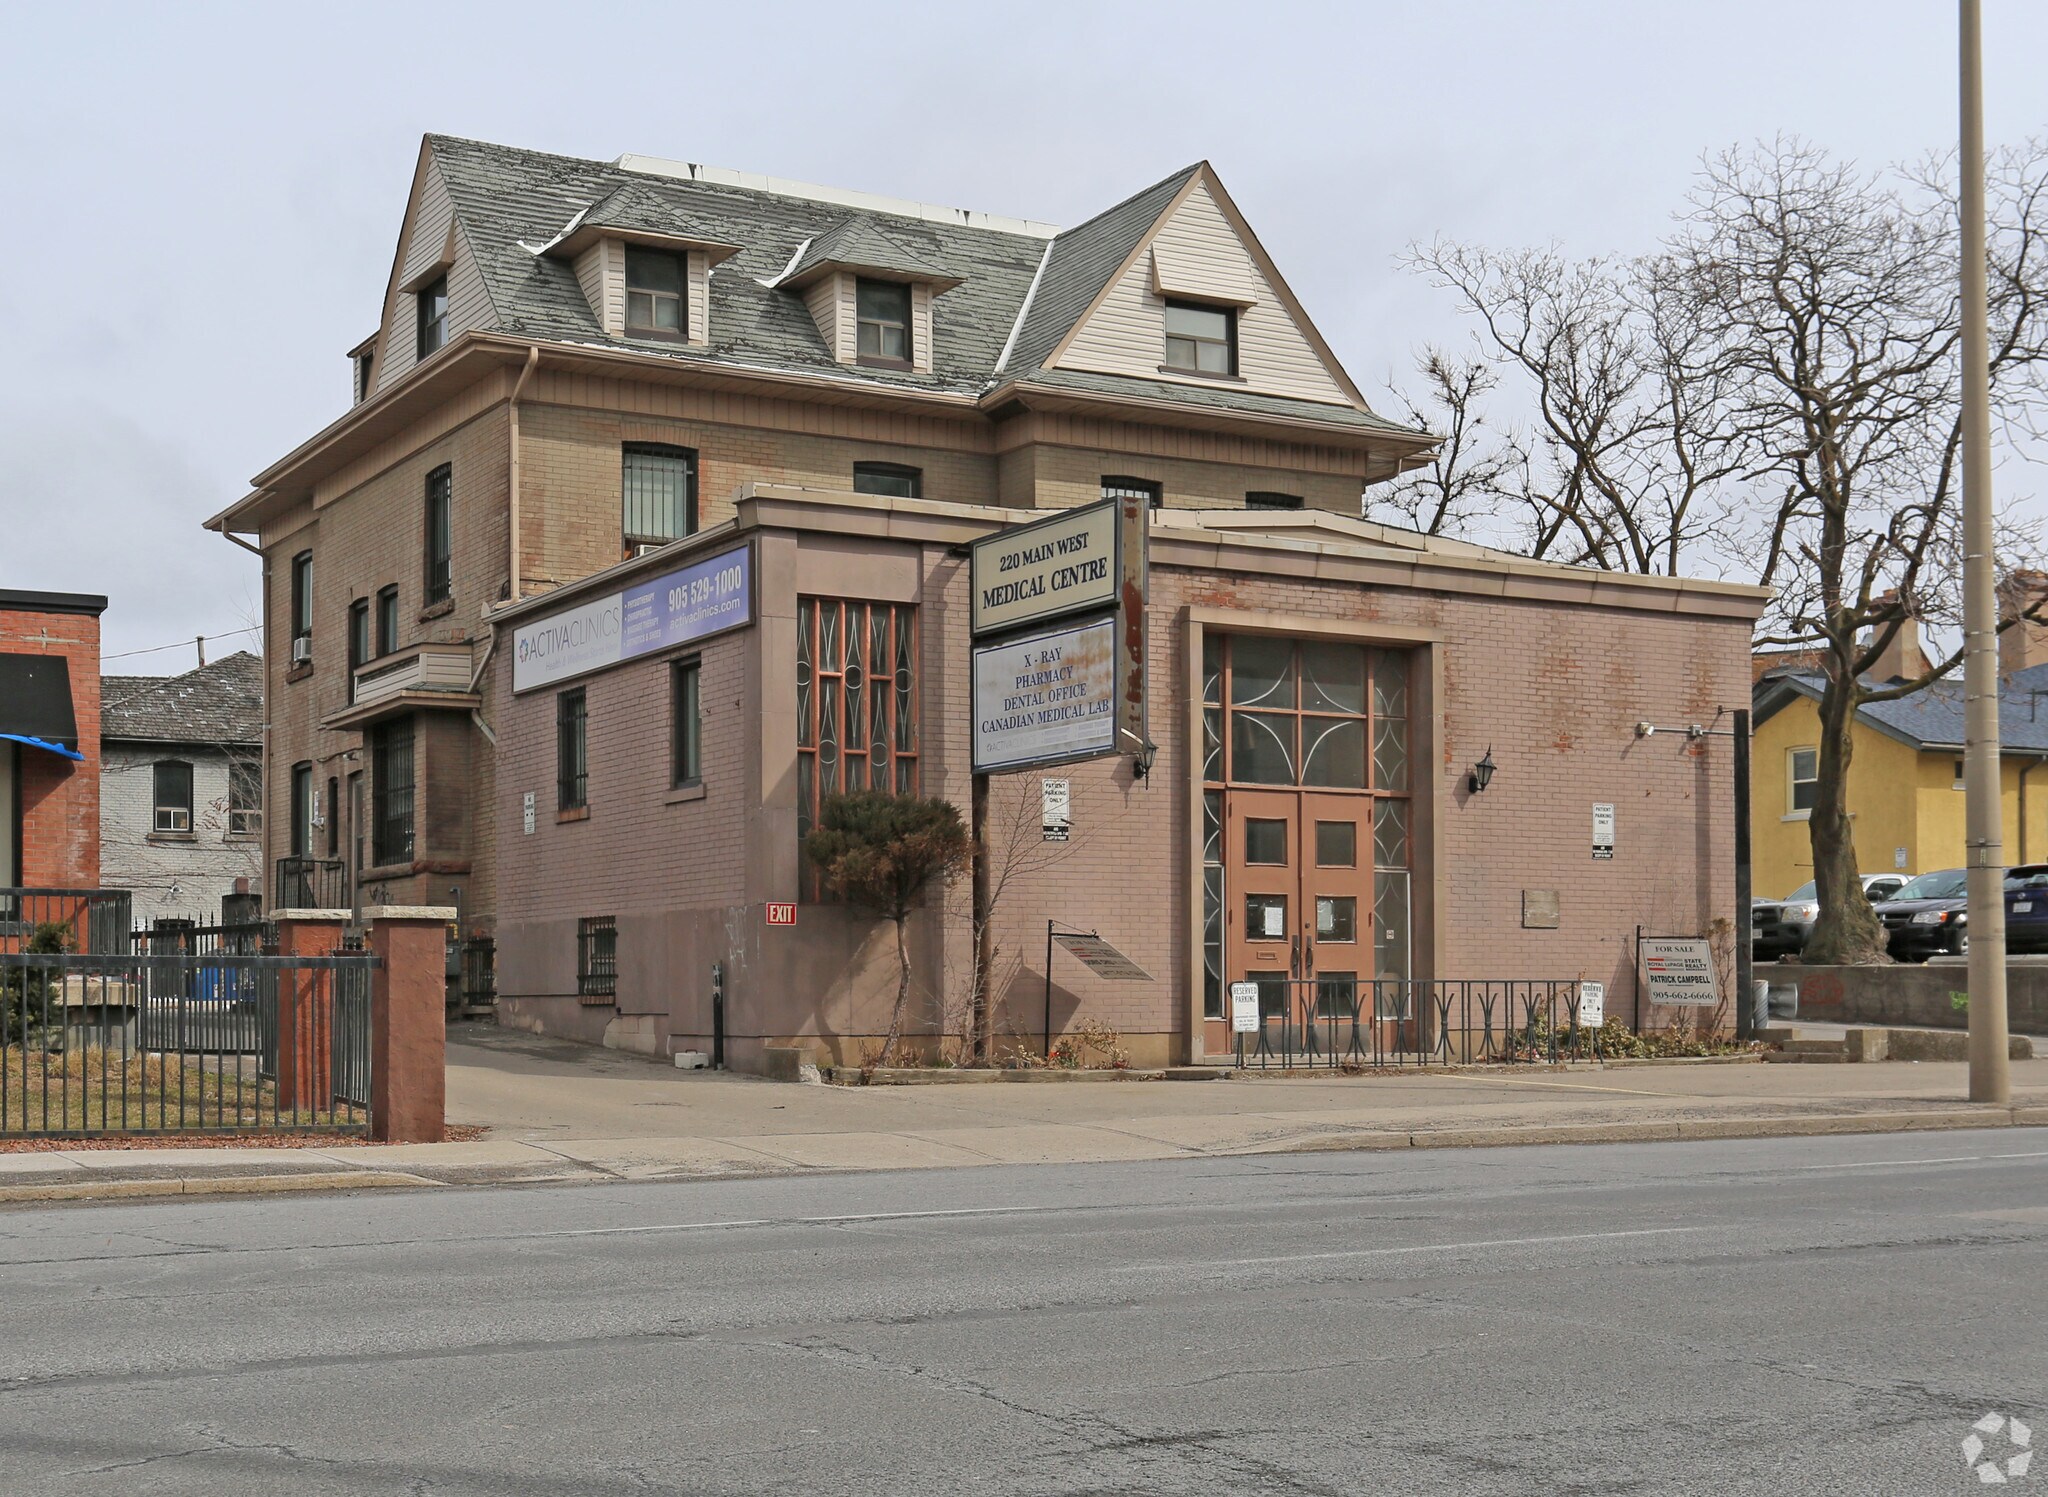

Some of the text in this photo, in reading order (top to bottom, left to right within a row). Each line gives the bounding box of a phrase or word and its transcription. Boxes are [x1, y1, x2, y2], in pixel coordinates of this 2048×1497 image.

[1000, 532, 1089, 572] 220 MAIN WEST
[669, 565, 741, 612] 905 529-1000
[983, 557, 1107, 610] MEDICAL CENTRE
[670, 598, 740, 630] activaclinics.com
[529, 607, 620, 660] ACTIVACLINICS
[1024, 654, 1032, 668] X
[1041, 647, 1062, 664] RAY
[1015, 665, 1073, 689] PHARMACY
[1004, 683, 1087, 711] DENTAL OFFICE
[982, 699, 1109, 734] CANADIAN MEDICAL LAB
[769, 905, 793, 922] EXIT
[1233, 986, 1257, 995] RESERVED
[1650, 975, 1711, 984] PATRICK CAMPBELL
[1235, 995, 1256, 1003] PARKING
[1653, 991, 1713, 1000] 905-662-6666
